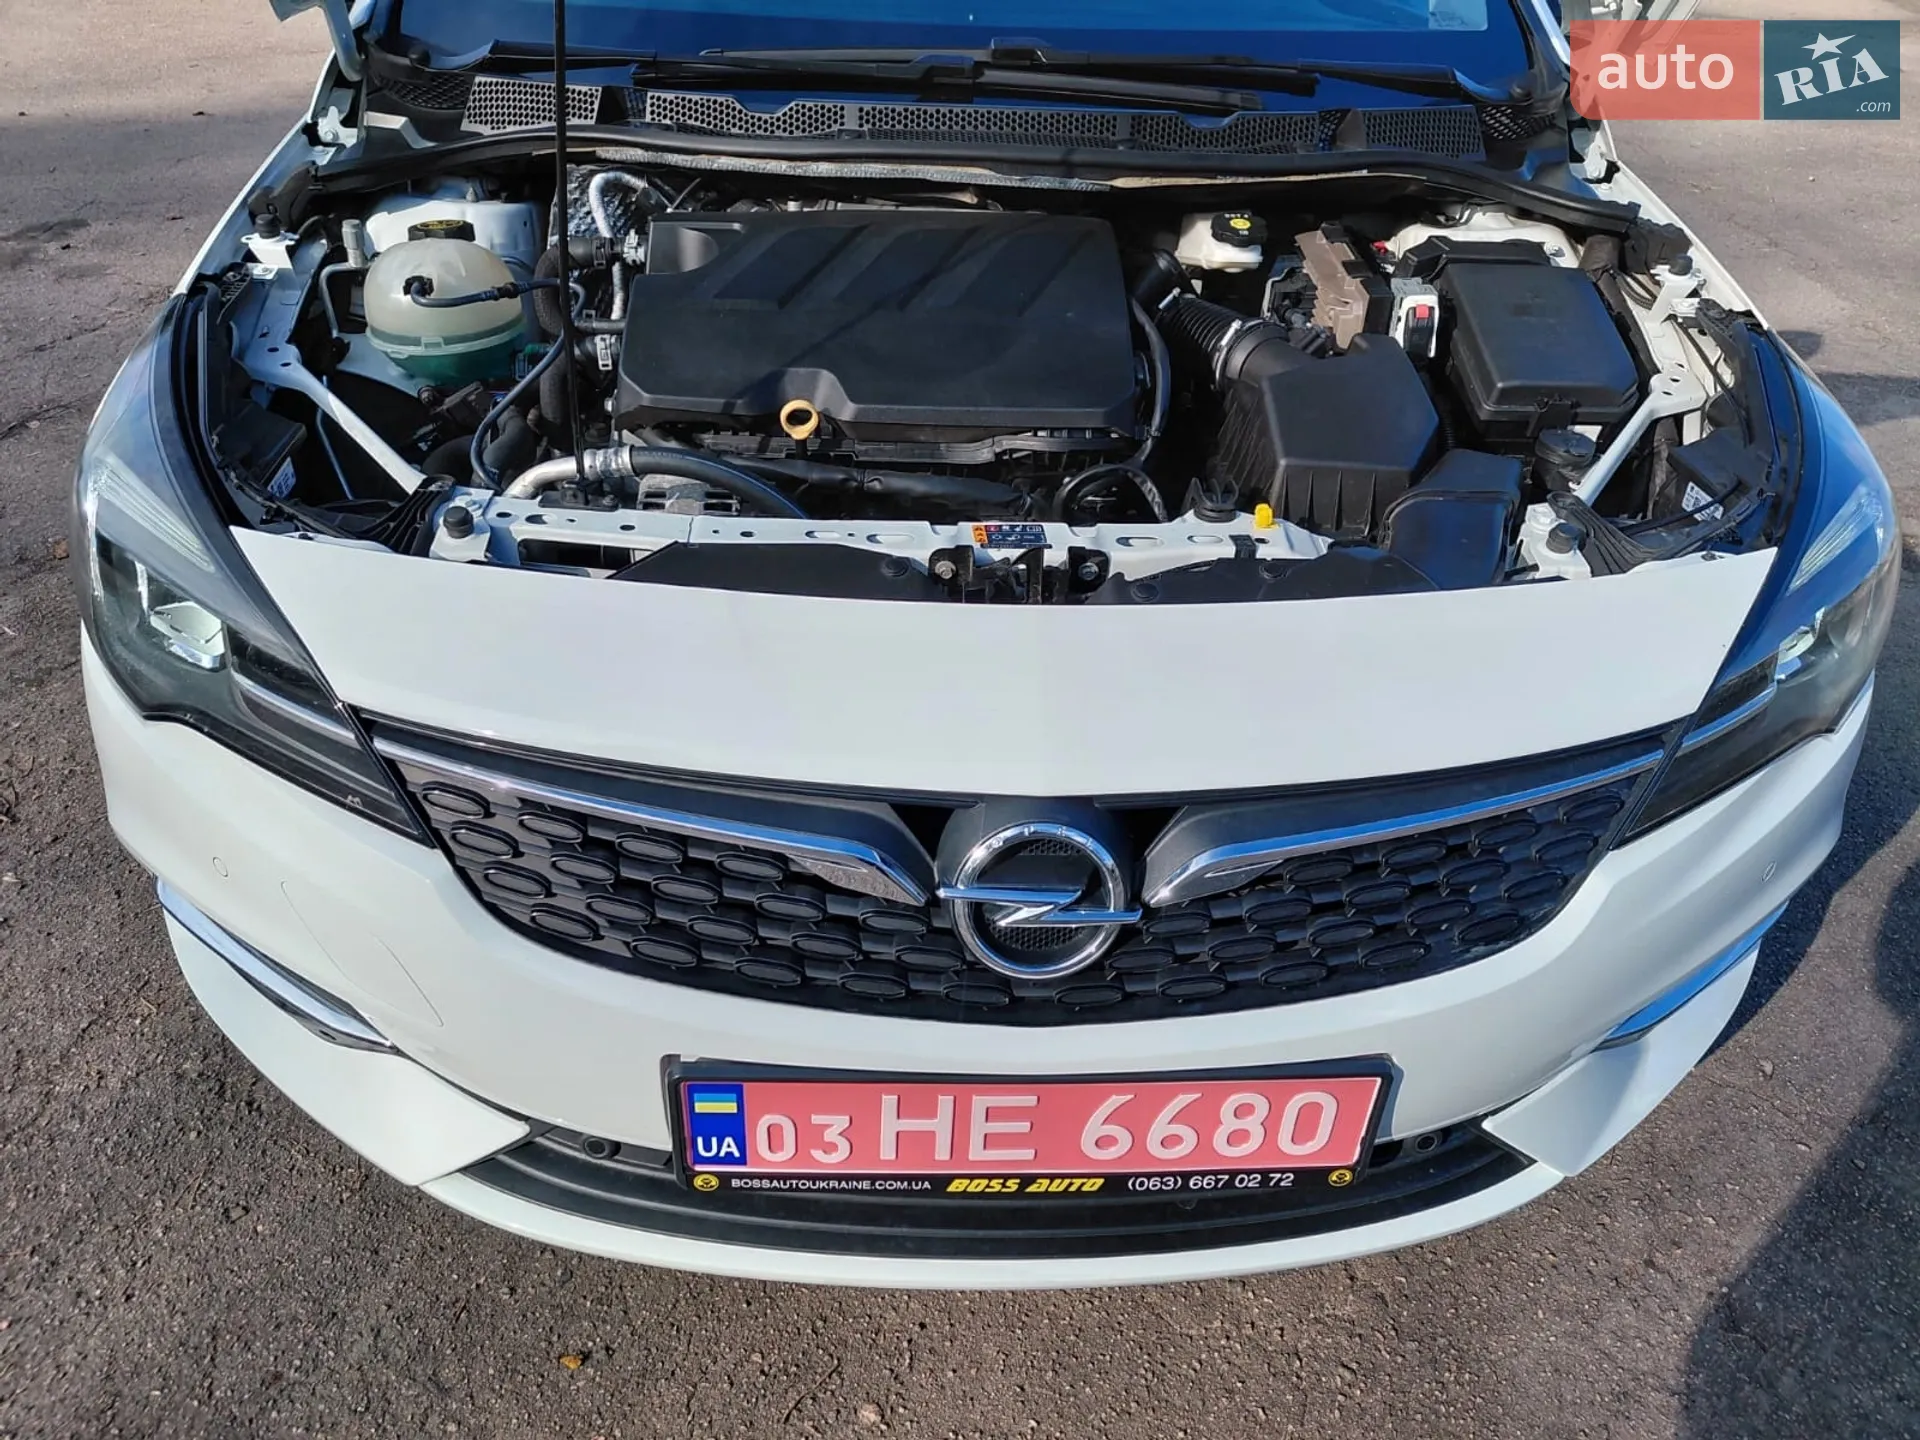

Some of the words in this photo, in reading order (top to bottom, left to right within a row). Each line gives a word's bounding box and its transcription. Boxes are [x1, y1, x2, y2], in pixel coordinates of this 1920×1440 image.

[755, 1114, 852, 1164] 03
[879, 1094, 1038, 1161] HE
[1080, 1091, 1338, 1161] 6680
[696, 1136, 740, 1158] UA
[731, 1178, 932, 1191] BOSSAUTOUKRAINE.COM.UA
[946, 1178, 1021, 1192] BOSS
[1127, 1176, 1182, 1191] (063)
[1189, 1175, 1230, 1189] 667
[1234, 1174, 1261, 1188] 02
[1268, 1173, 1295, 1187] 72
